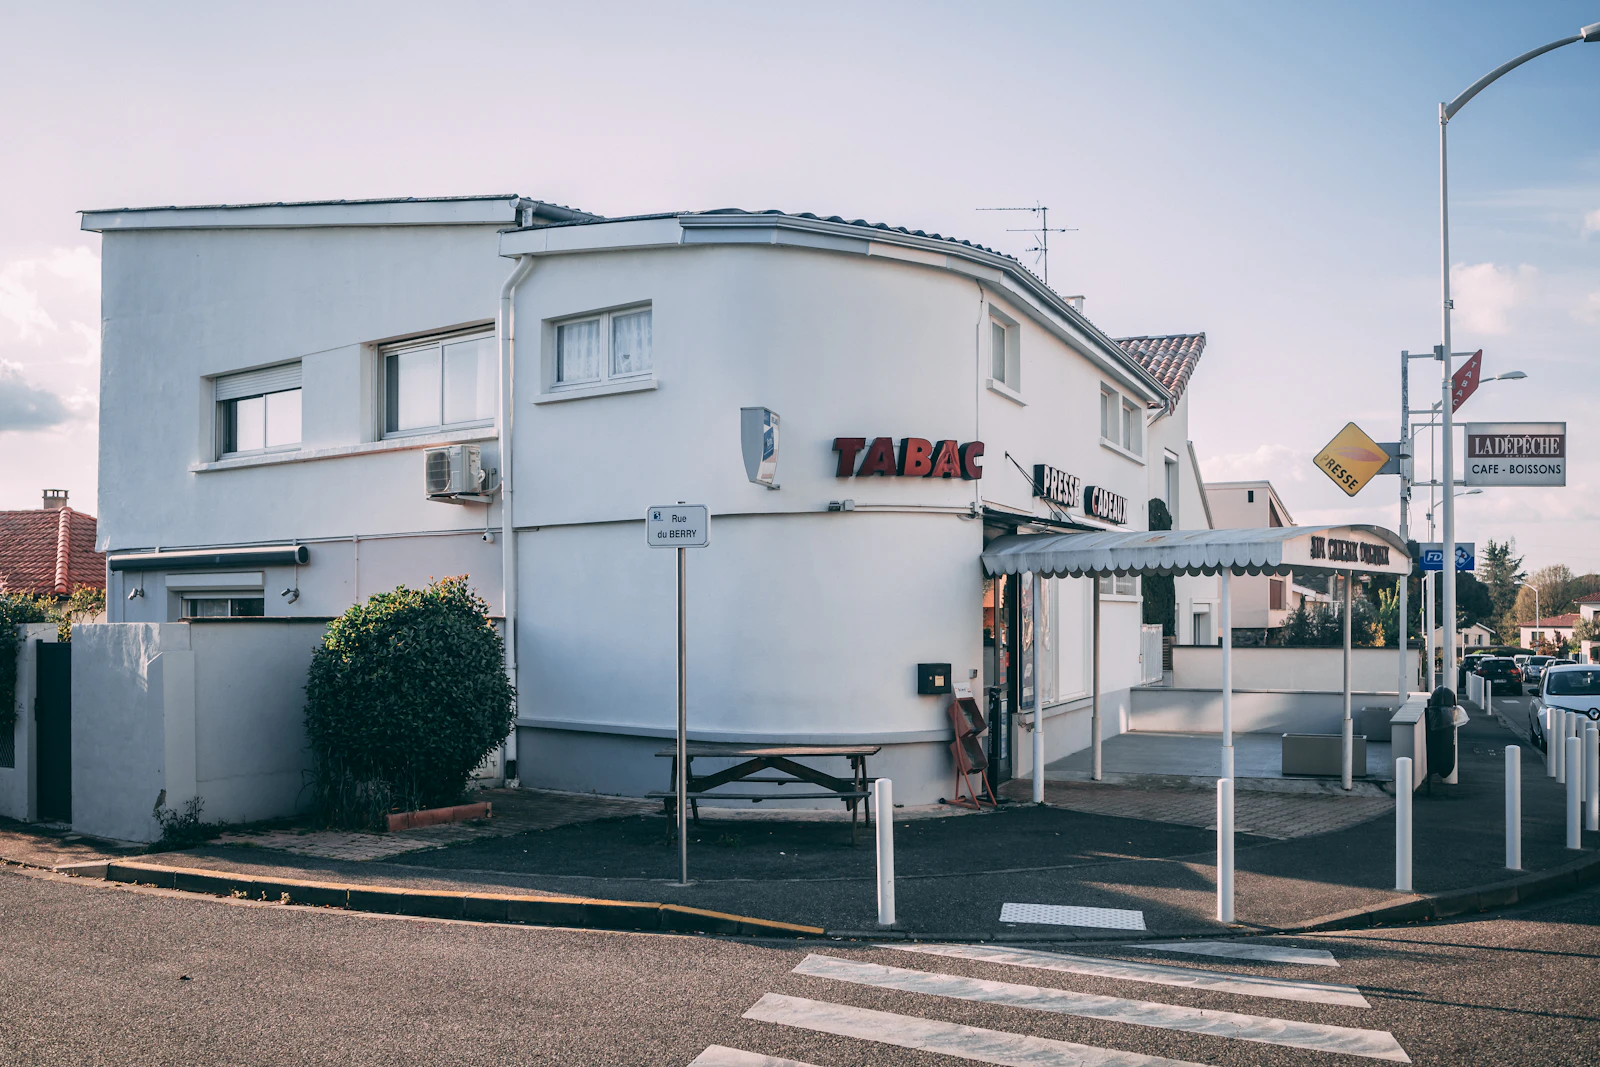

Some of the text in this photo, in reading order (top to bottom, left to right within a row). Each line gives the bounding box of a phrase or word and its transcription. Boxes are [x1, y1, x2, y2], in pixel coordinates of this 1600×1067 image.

[1452, 361, 1477, 406] TABAC
[832, 436, 985, 480] TABAC
[1319, 453, 1359, 491] PRESSE
[1472, 464, 1499, 475] CAFE
[1509, 464, 1561, 475] BOISSONS
[1042, 464, 1080, 508] PRESSE
[1090, 486, 1128, 524] CADEAUX
[657, 529, 697, 539] du BERRY
[671, 514, 687, 523] Rue
[1426, 552, 1443, 561] FD
